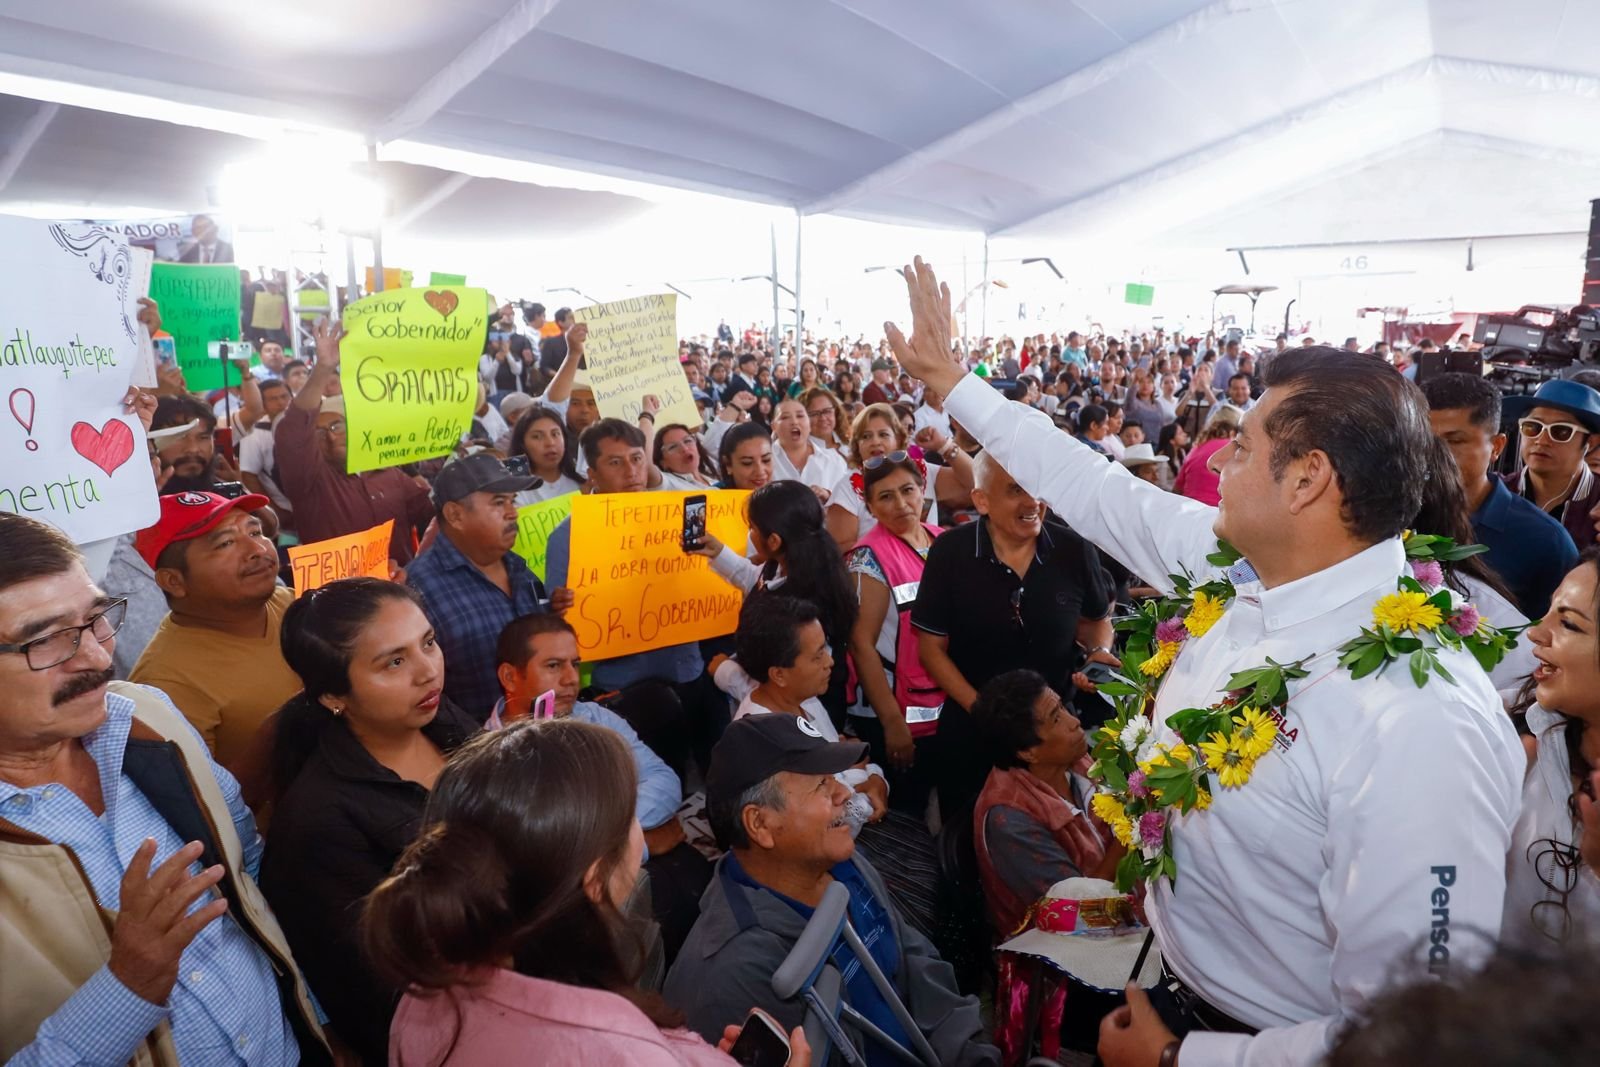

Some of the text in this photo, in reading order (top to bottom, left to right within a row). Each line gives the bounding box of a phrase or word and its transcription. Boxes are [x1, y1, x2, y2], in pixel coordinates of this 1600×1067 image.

[0, 327, 117, 379] atlauquitepec
[357, 355, 470, 405] GRACIAS
[620, 535, 634, 551] LE
[576, 567, 598, 589] LA
[610, 557, 648, 580] OBRA
